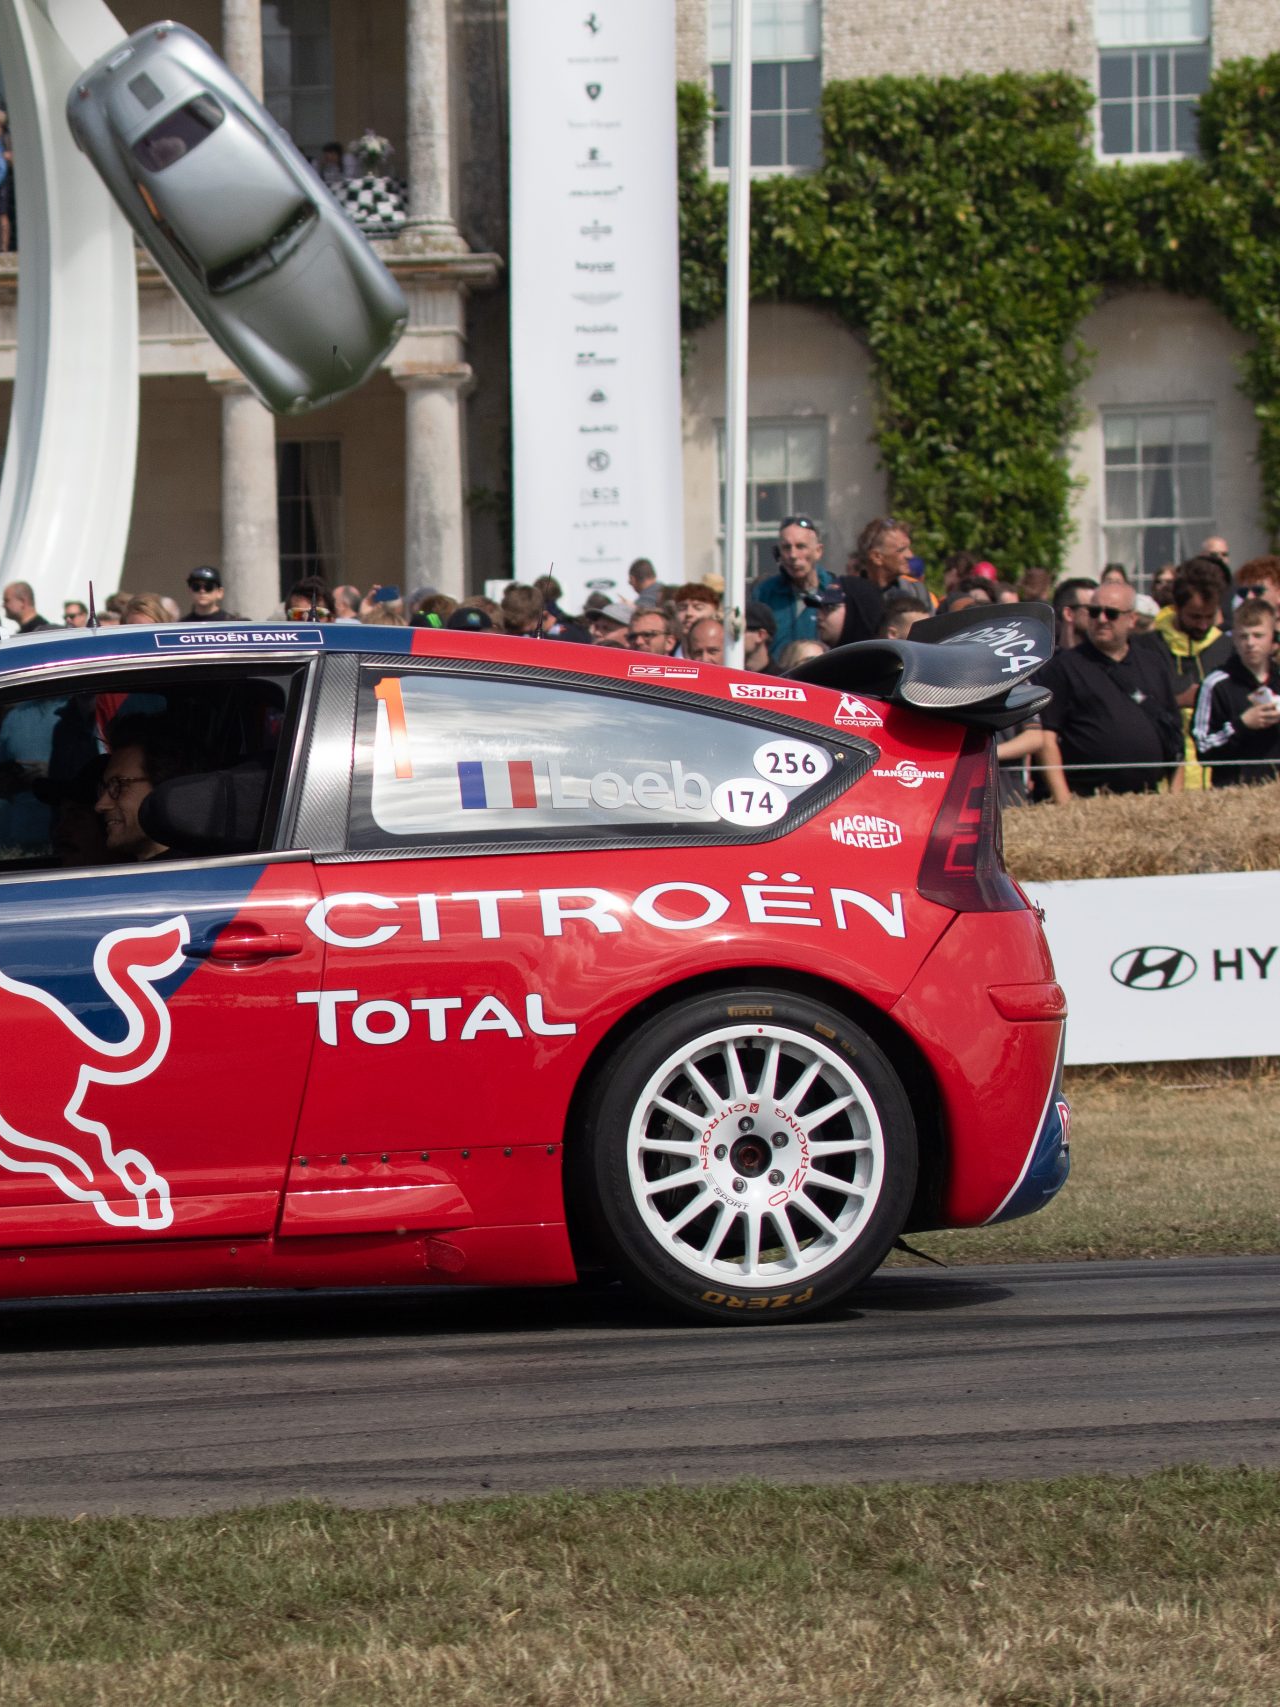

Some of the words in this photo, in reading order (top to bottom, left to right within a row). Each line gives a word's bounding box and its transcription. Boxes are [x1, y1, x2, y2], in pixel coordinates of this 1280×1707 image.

[179, 632, 249, 643] CITROËN
[252, 633, 299, 642] BANK
[736, 686, 800, 700] Sabelt
[375, 677, 412, 779] 1
[766, 752, 817, 774] 256
[872, 769, 945, 779] TRANSALLIANCE
[547, 760, 712, 810] Loeb
[727, 790, 773, 813] 174
[830, 815, 902, 834] MAGNETI
[305, 871, 907, 948] CITROËN
[296, 989, 577, 1047] TOTAL
